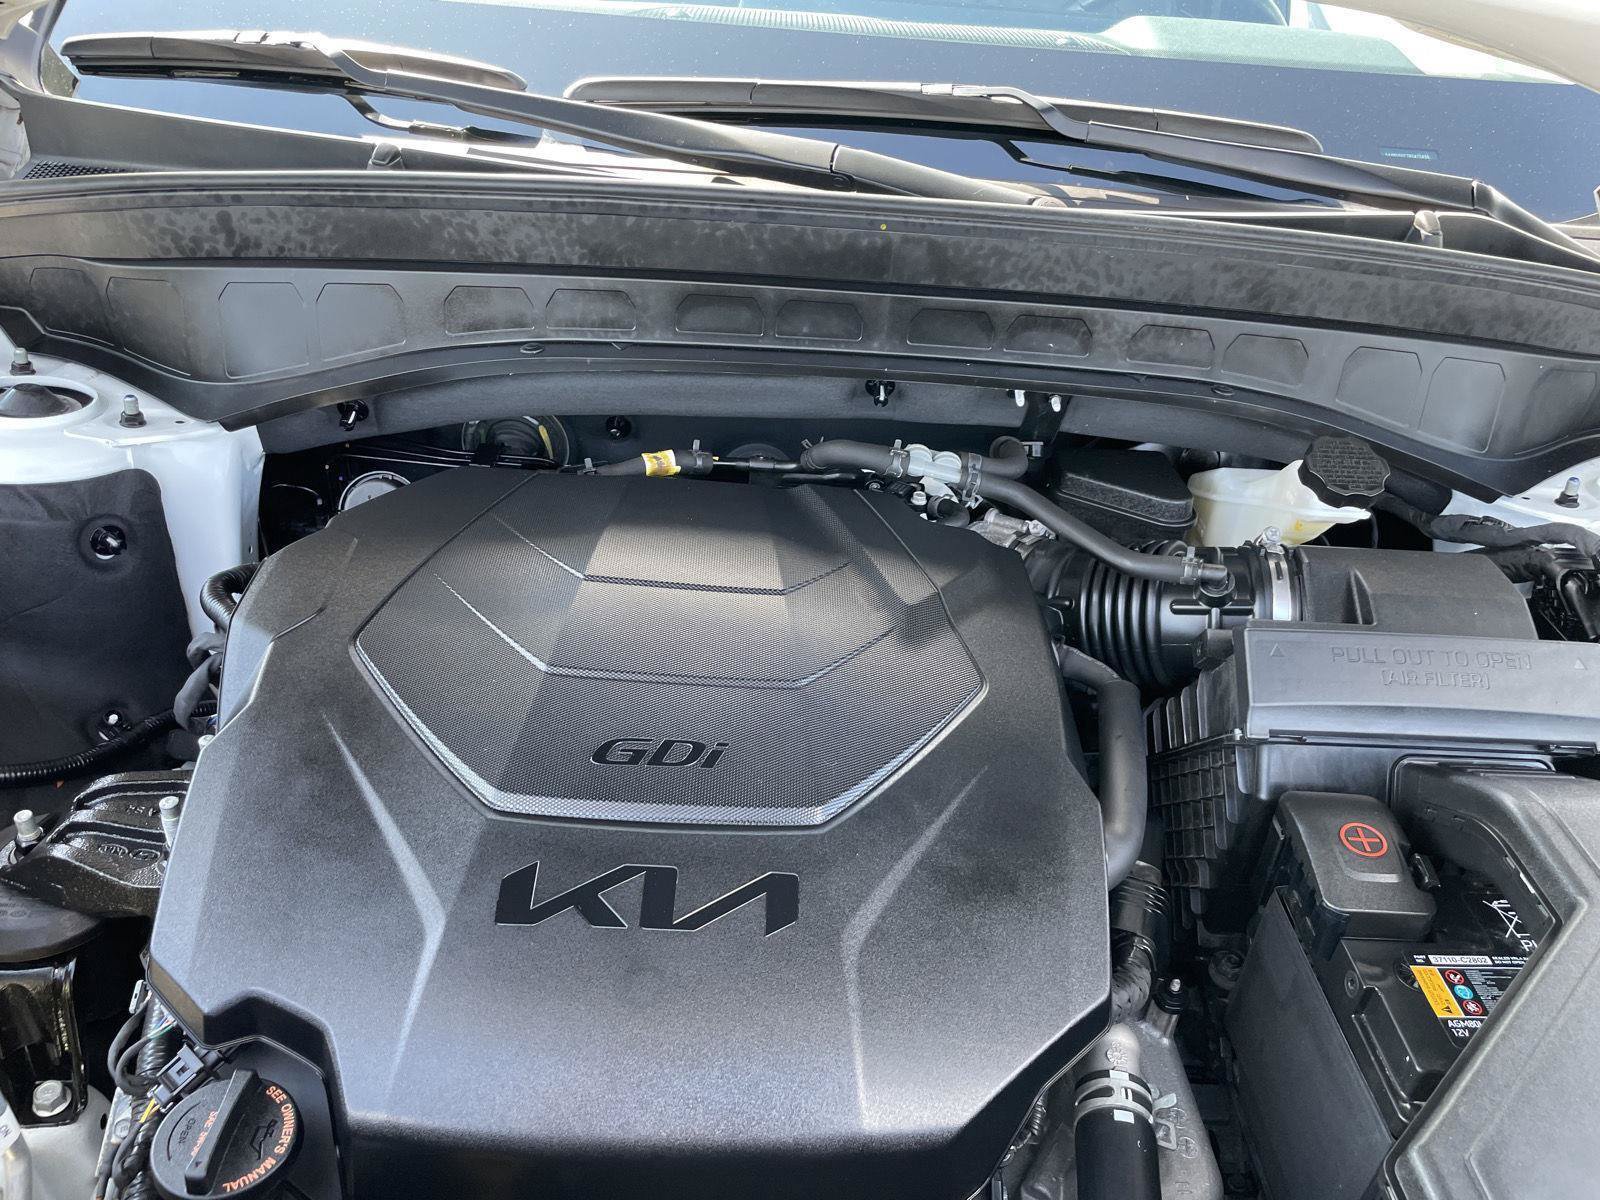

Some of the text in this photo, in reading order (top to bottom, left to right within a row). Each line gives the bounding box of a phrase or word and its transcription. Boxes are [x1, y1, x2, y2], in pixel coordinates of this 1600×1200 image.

[1330, 646, 1532, 670] PULL OUT TO OPEN
[590, 737, 729, 769] GDi
[494, 860, 800, 938] KIA
[1432, 956, 1489, 964] 37110-C2802
[1451, 1028, 1470, 1037] 12V
[265, 1085, 287, 1104] SEE
[178, 1118, 196, 1143] OPEN
[274, 1103, 295, 1154] OWNER'S
[223, 1156, 276, 1192] MANUAL
